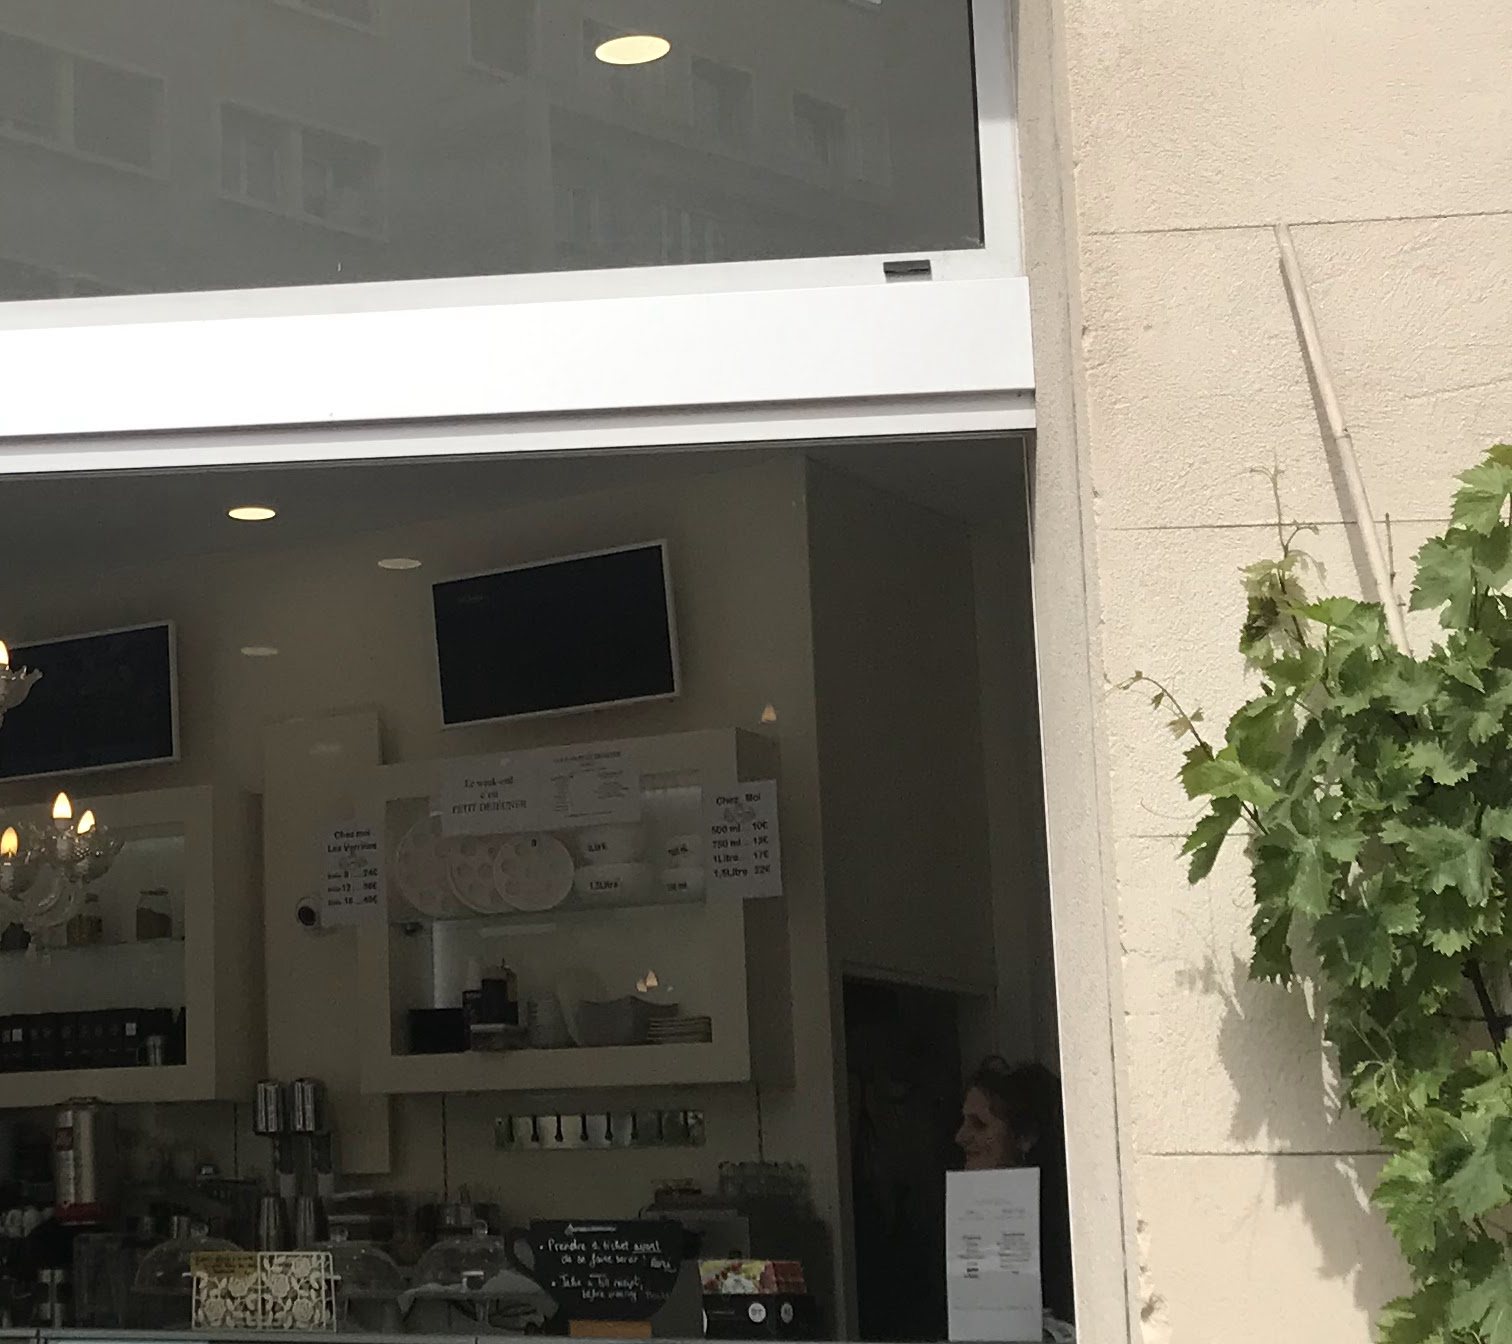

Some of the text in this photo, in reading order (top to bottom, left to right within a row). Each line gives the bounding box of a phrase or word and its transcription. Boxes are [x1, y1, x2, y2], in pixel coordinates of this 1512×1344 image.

[716, 796, 739, 806] Chez
[548, 1238, 587, 1252] Prendre
[603, 1240, 630, 1252] ticket
